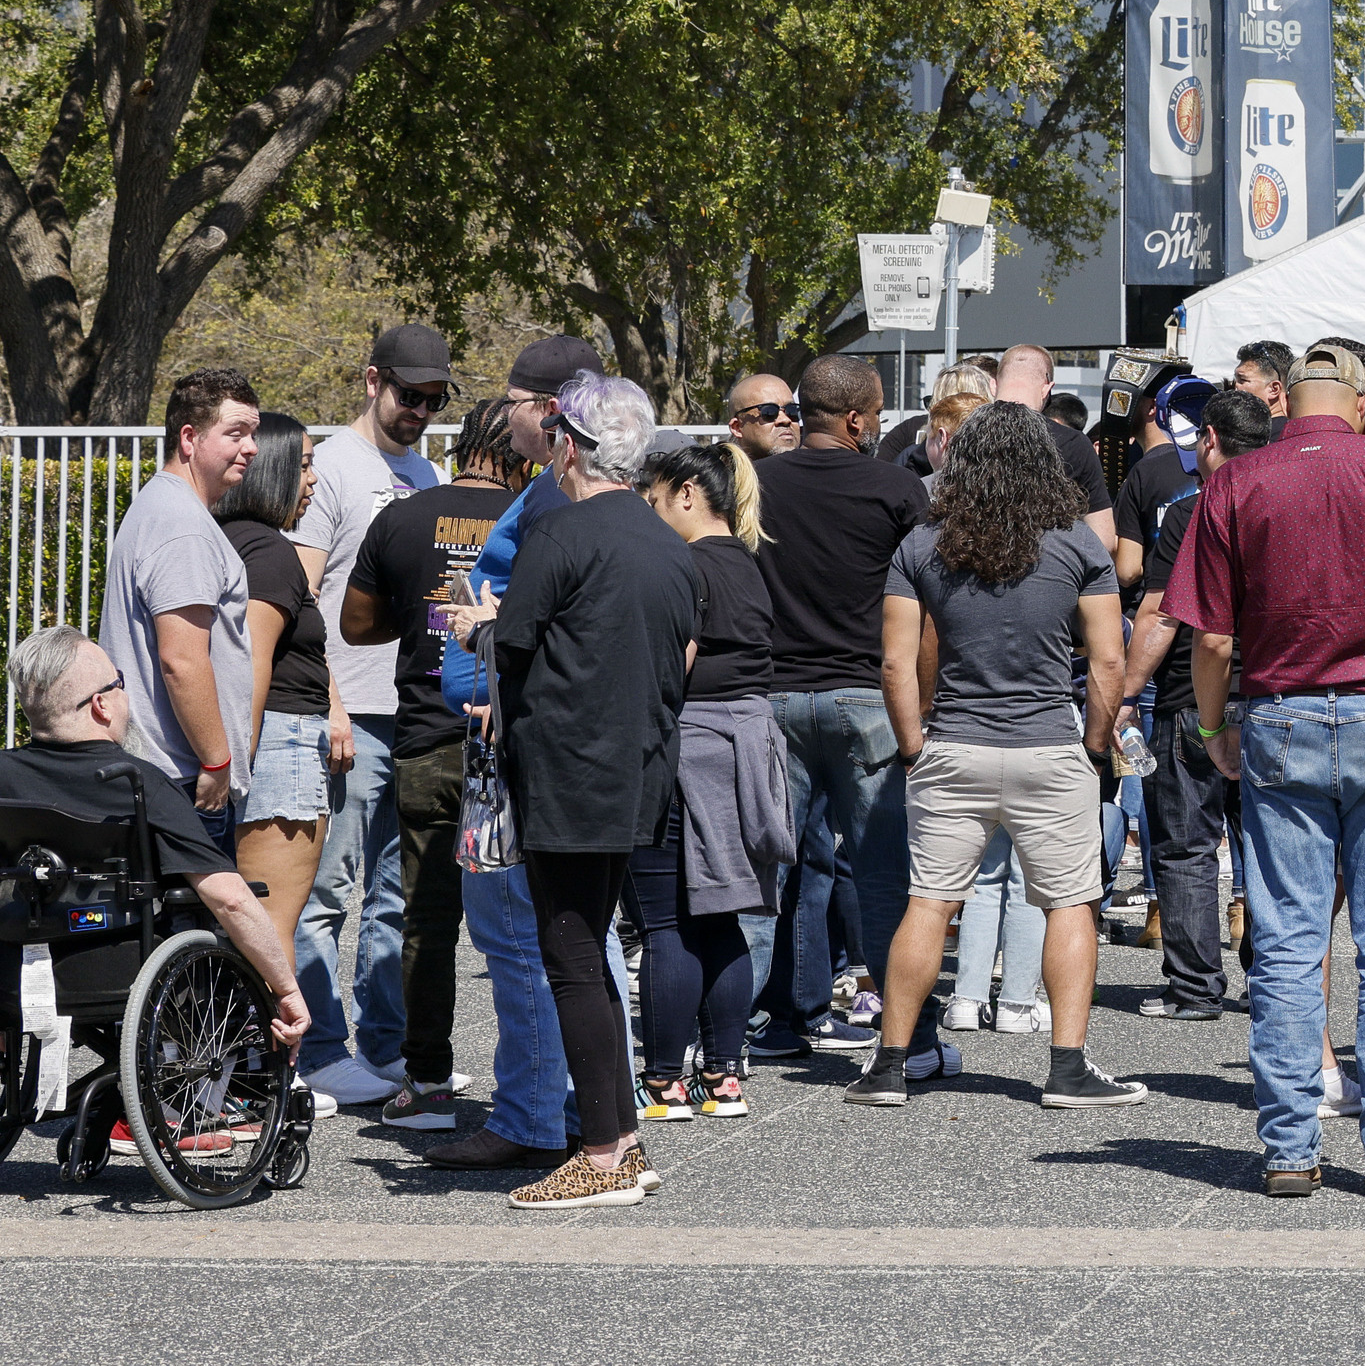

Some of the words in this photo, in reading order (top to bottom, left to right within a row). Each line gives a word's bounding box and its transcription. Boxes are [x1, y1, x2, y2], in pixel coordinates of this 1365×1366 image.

[1239, 12, 1302, 46] House
[1158, 15, 1208, 71] Lite
[1171, 79, 1191, 102] FINE
[1246, 103, 1295, 158] Lite
[872, 244, 896, 255] METAL
[898, 244, 935, 255] DETECTOR
[883, 256, 923, 267] SCREENING
[880, 273, 905, 283] REMOVE
[873, 283, 887, 292] CELL
[888, 283, 912, 293] PHONES
[884, 293, 901, 302] ONLY
[434, 542, 463, 551] BECKY
